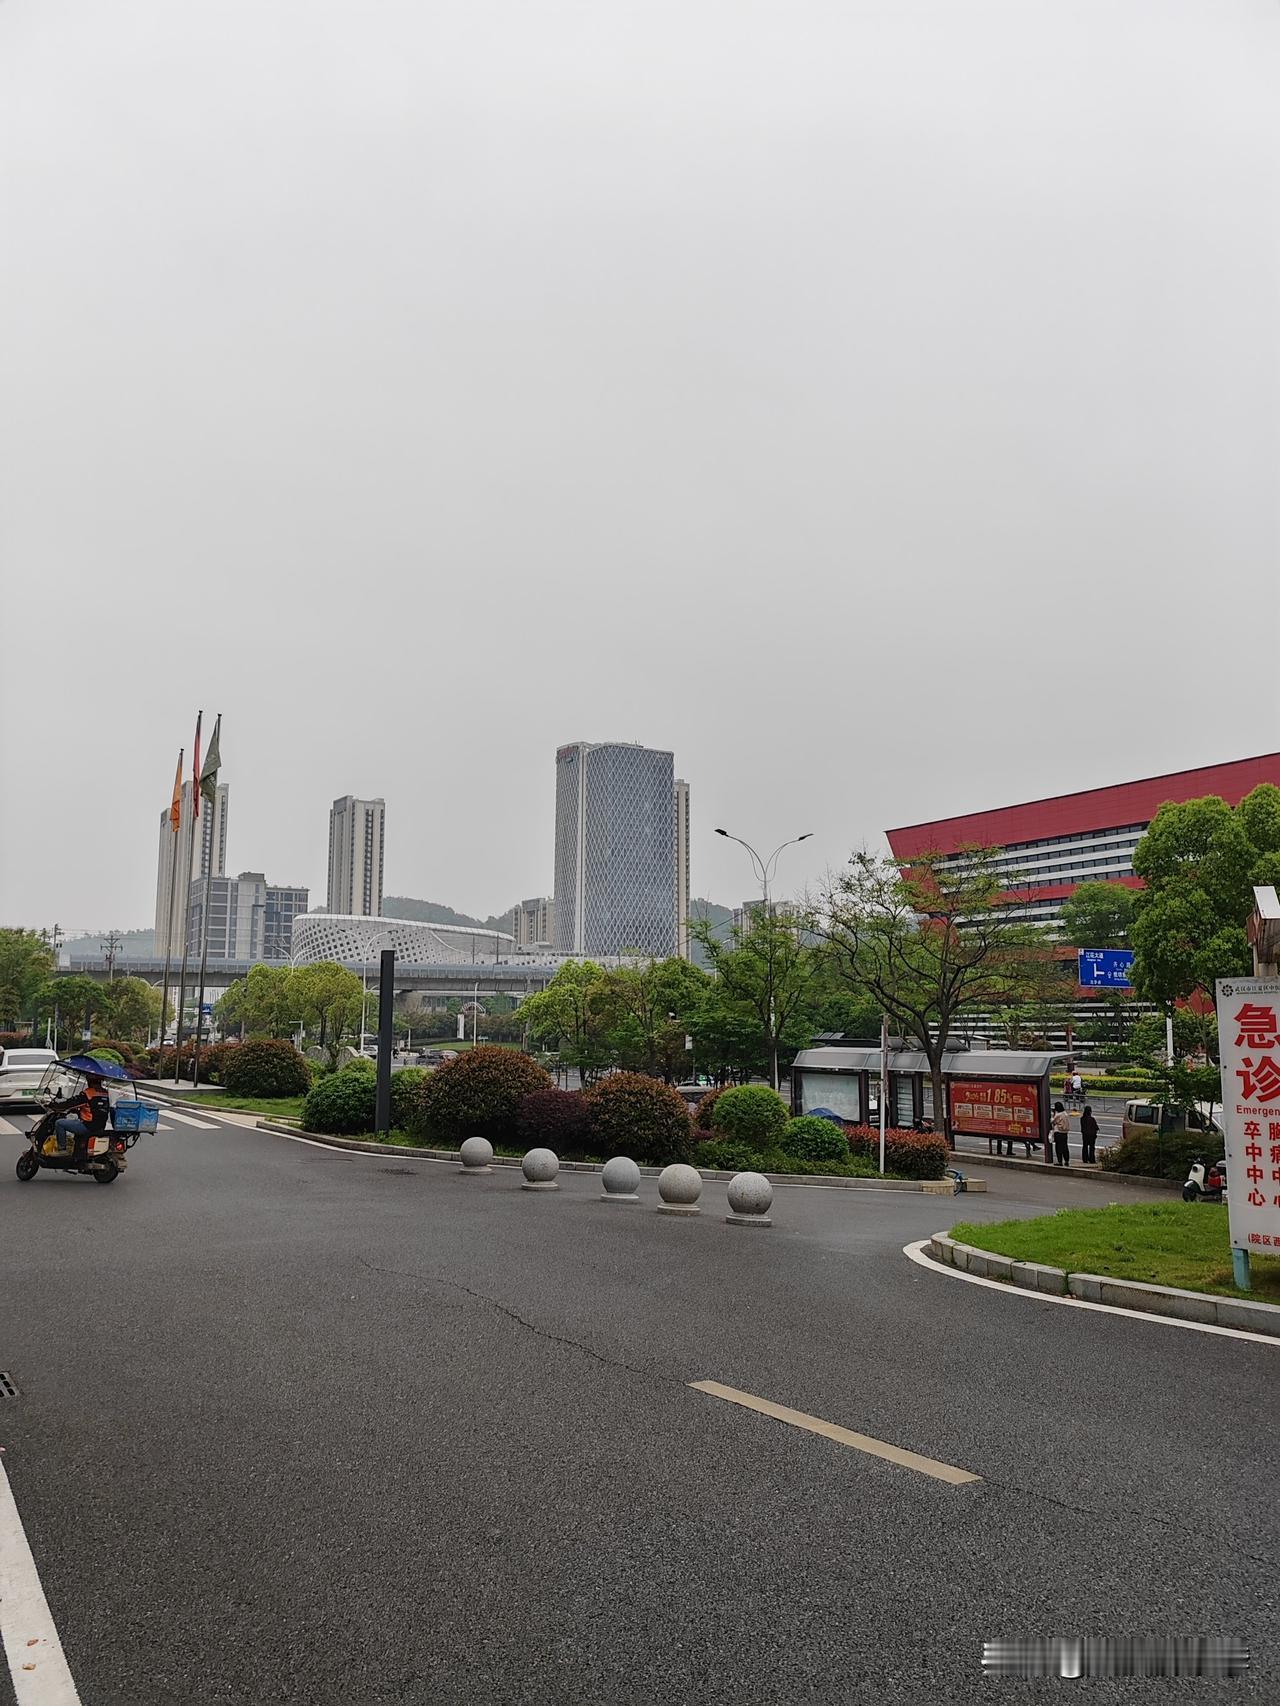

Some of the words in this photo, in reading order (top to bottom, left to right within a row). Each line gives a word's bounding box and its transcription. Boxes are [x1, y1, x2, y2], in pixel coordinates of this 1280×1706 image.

[1233, 1003, 1280, 1102] 急诊
[1244, 1120, 1266, 1207] 卒中中心
